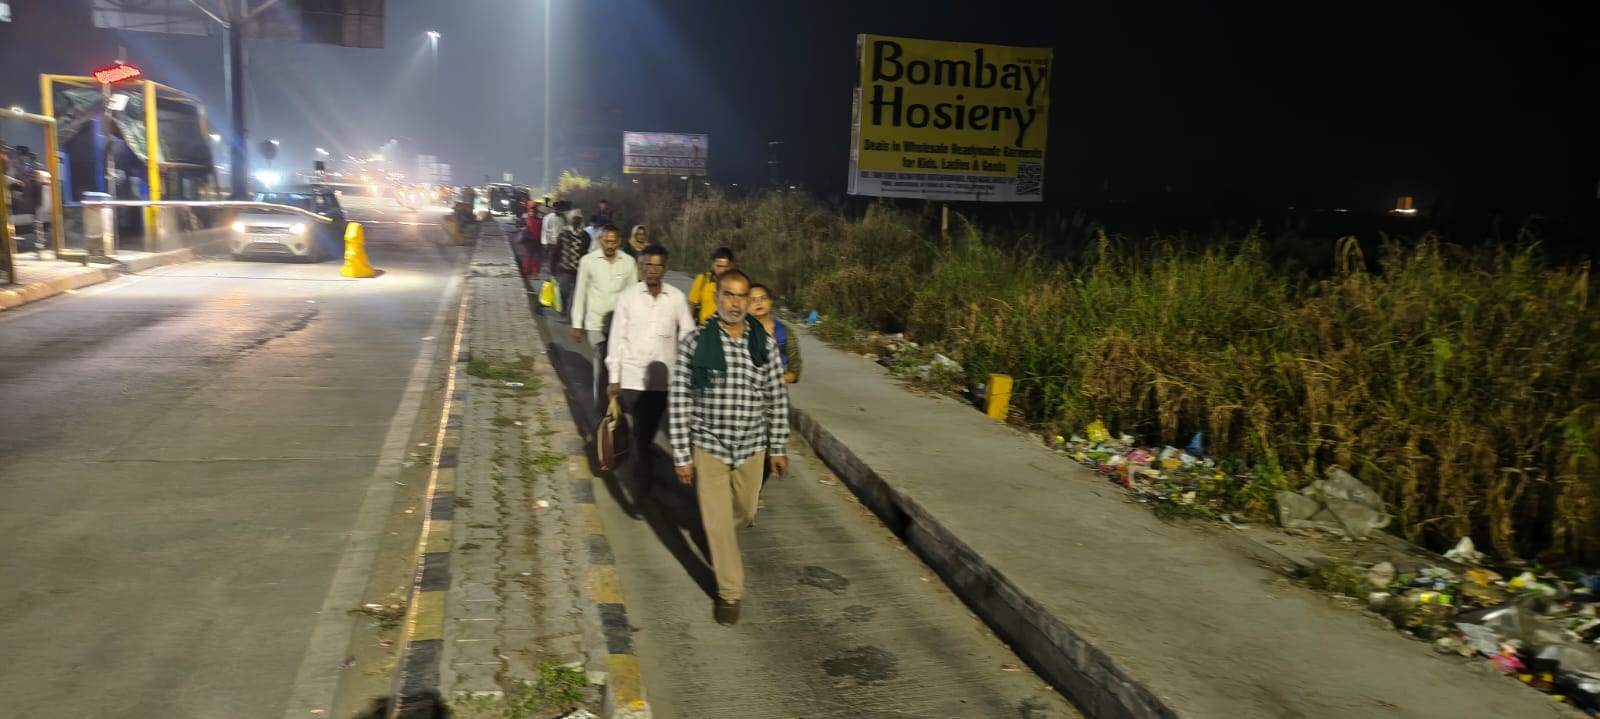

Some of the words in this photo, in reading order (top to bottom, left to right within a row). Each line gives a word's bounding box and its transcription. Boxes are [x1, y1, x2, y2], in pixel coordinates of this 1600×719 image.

[872, 41, 1046, 106] Bombay
[870, 85, 1036, 147] Hosiery
[864, 139, 889, 151] Deals
[893, 140, 901, 151] in
[904, 141, 949, 153] Wholesale
[952, 144, 1000, 157] Readymade
[1004, 146, 1042, 158] Garments
[902, 156, 915, 168] for
[942, 158, 969, 170] Ladies
[973, 160, 979, 170] &
